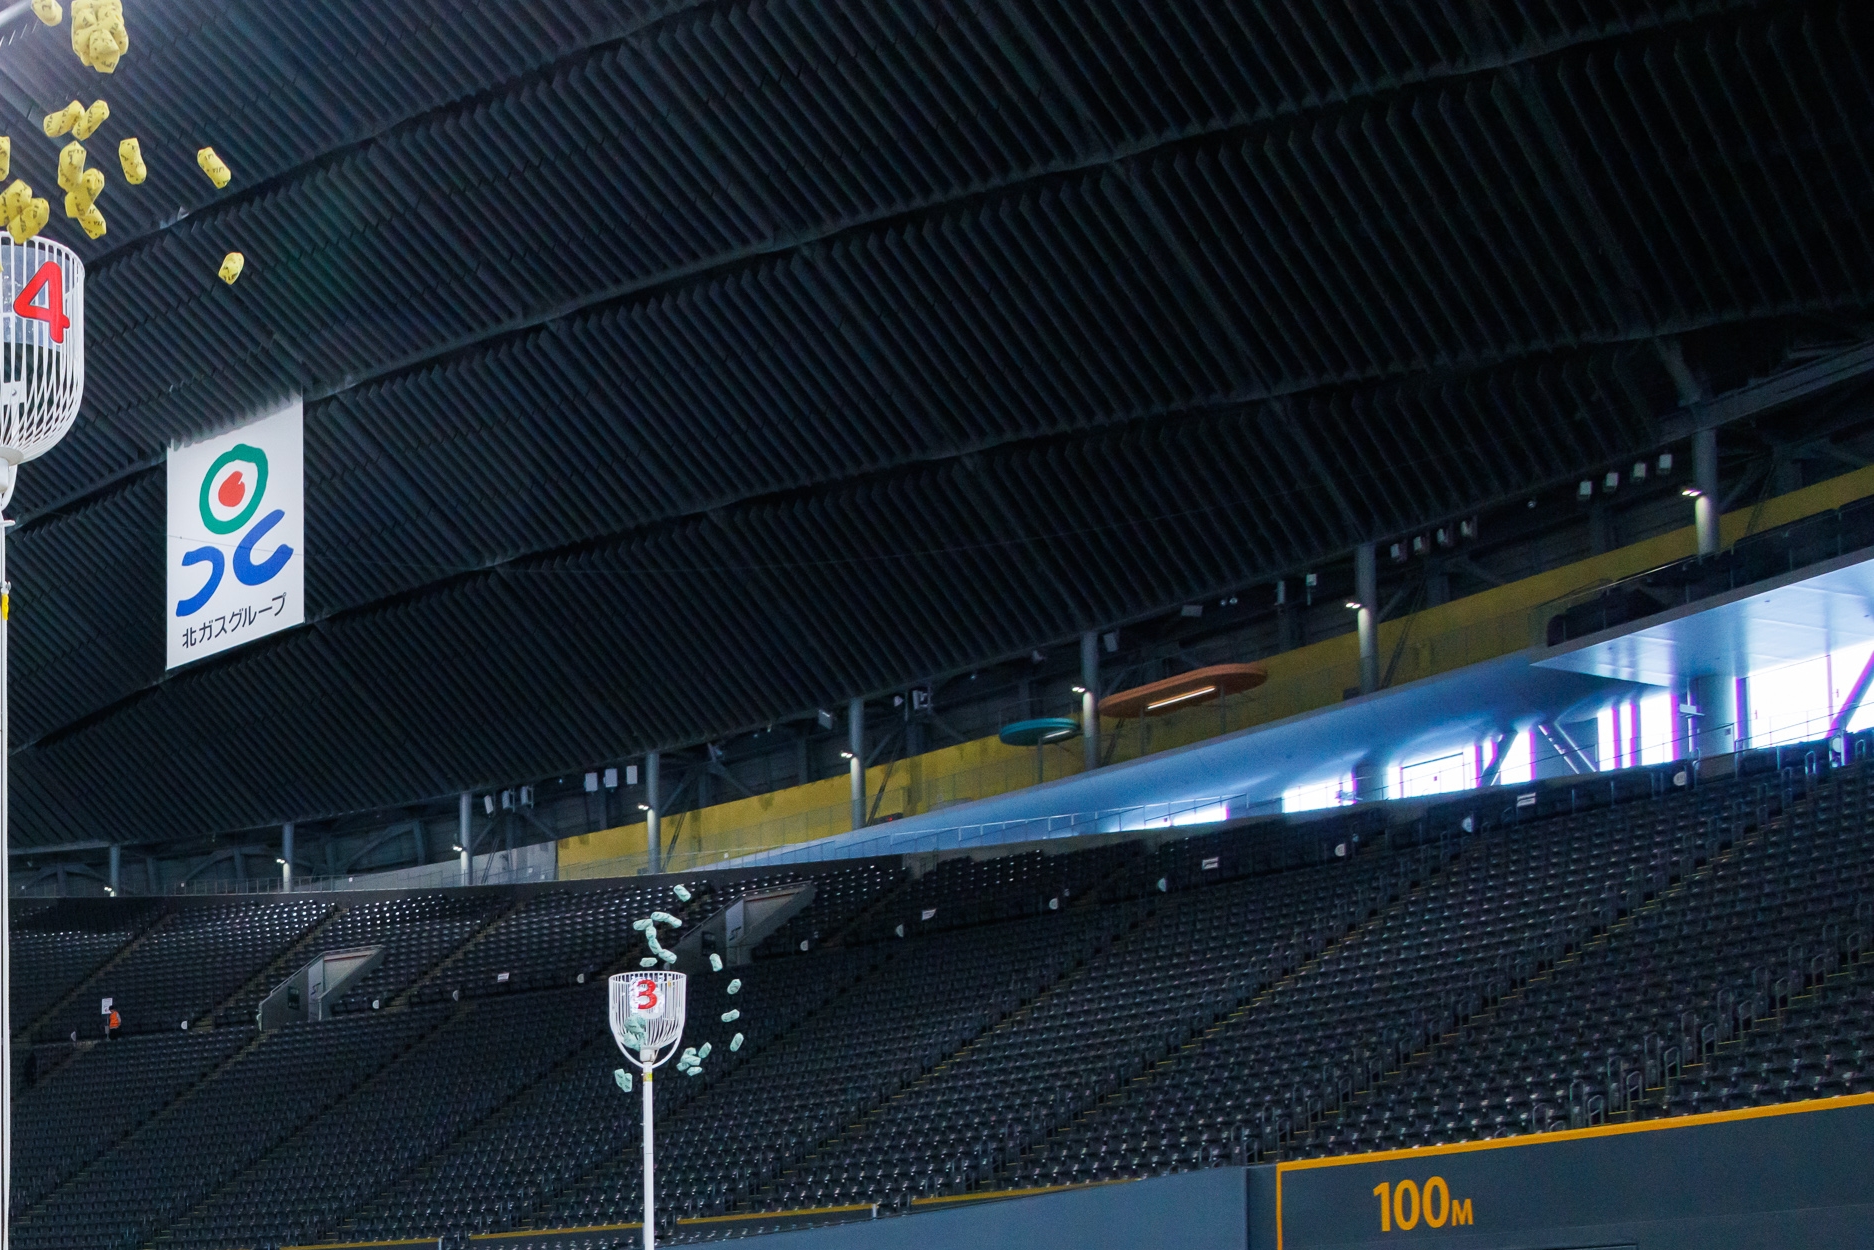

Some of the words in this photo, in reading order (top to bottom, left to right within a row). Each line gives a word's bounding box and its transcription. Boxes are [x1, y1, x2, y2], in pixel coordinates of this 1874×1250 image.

[13, 260, 71, 344] 4
[181, 591, 287, 649] 北ガスグループ
[636, 979, 658, 1010] 3
